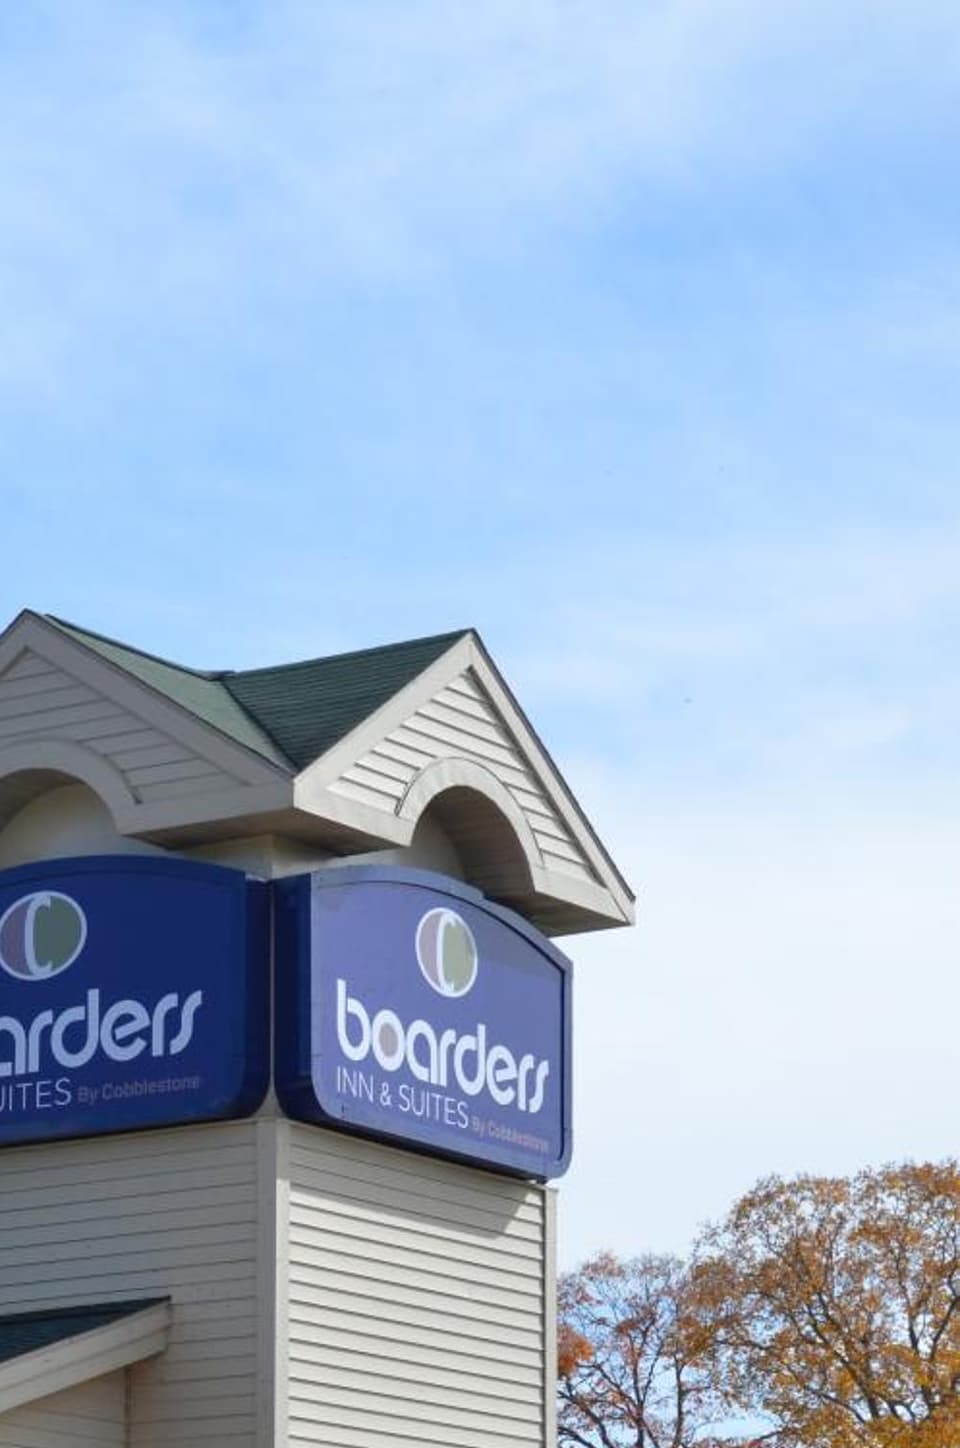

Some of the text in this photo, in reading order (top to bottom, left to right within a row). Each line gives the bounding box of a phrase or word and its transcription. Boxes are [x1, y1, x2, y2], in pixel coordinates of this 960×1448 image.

[337, 978, 549, 1113] boarders
[77, 1086, 97, 1106] By
[337, 1065, 374, 1104] INN
[380, 1081, 392, 1106] &
[399, 1084, 468, 1129] SUITES
